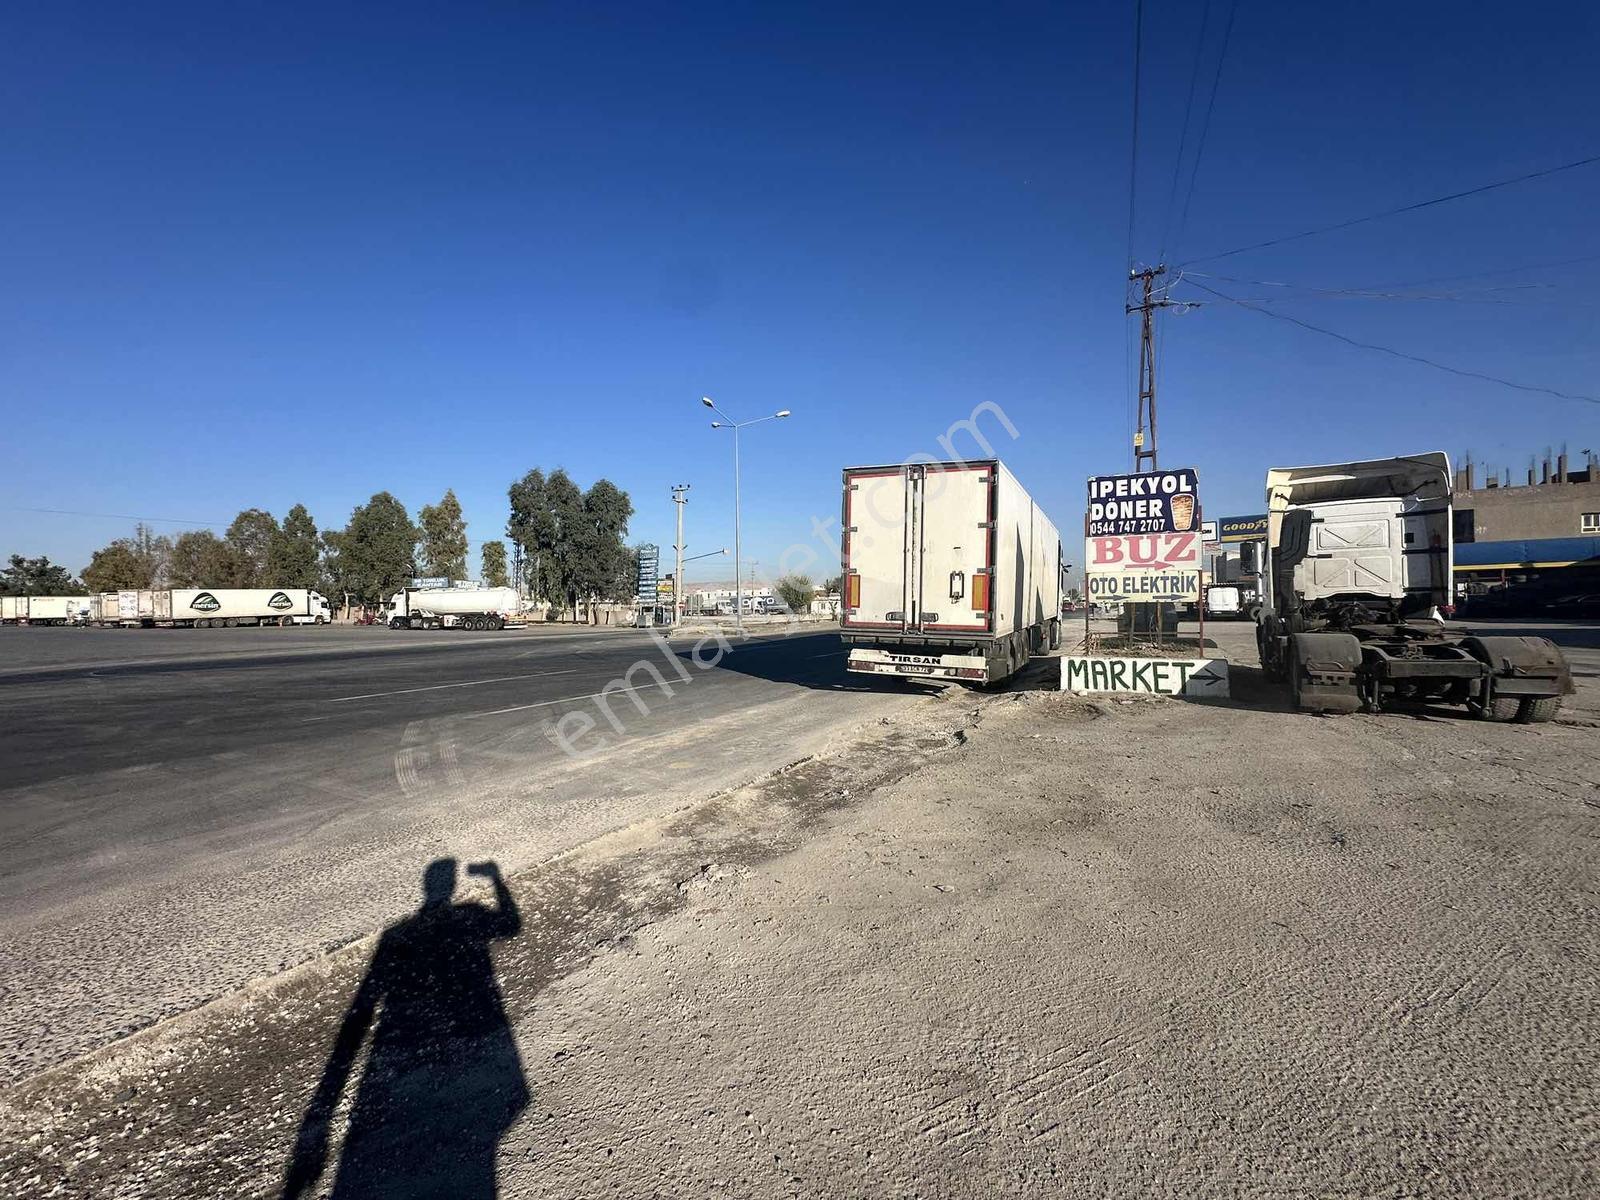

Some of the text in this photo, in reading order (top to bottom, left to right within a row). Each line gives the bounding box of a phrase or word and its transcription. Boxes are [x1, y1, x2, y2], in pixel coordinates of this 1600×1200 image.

[1091, 474, 1192, 499] İPEKYOL
[1091, 498, 1163, 521] DÖNER
[1091, 518, 1165, 534] 0544 747 2707
[1091, 533, 1197, 565] BUZ
[1090, 572, 1198, 594] OTO ELEKTRİK
[890, 655, 941, 665] TIRSAN
[1066, 659, 1195, 695] MARKET
